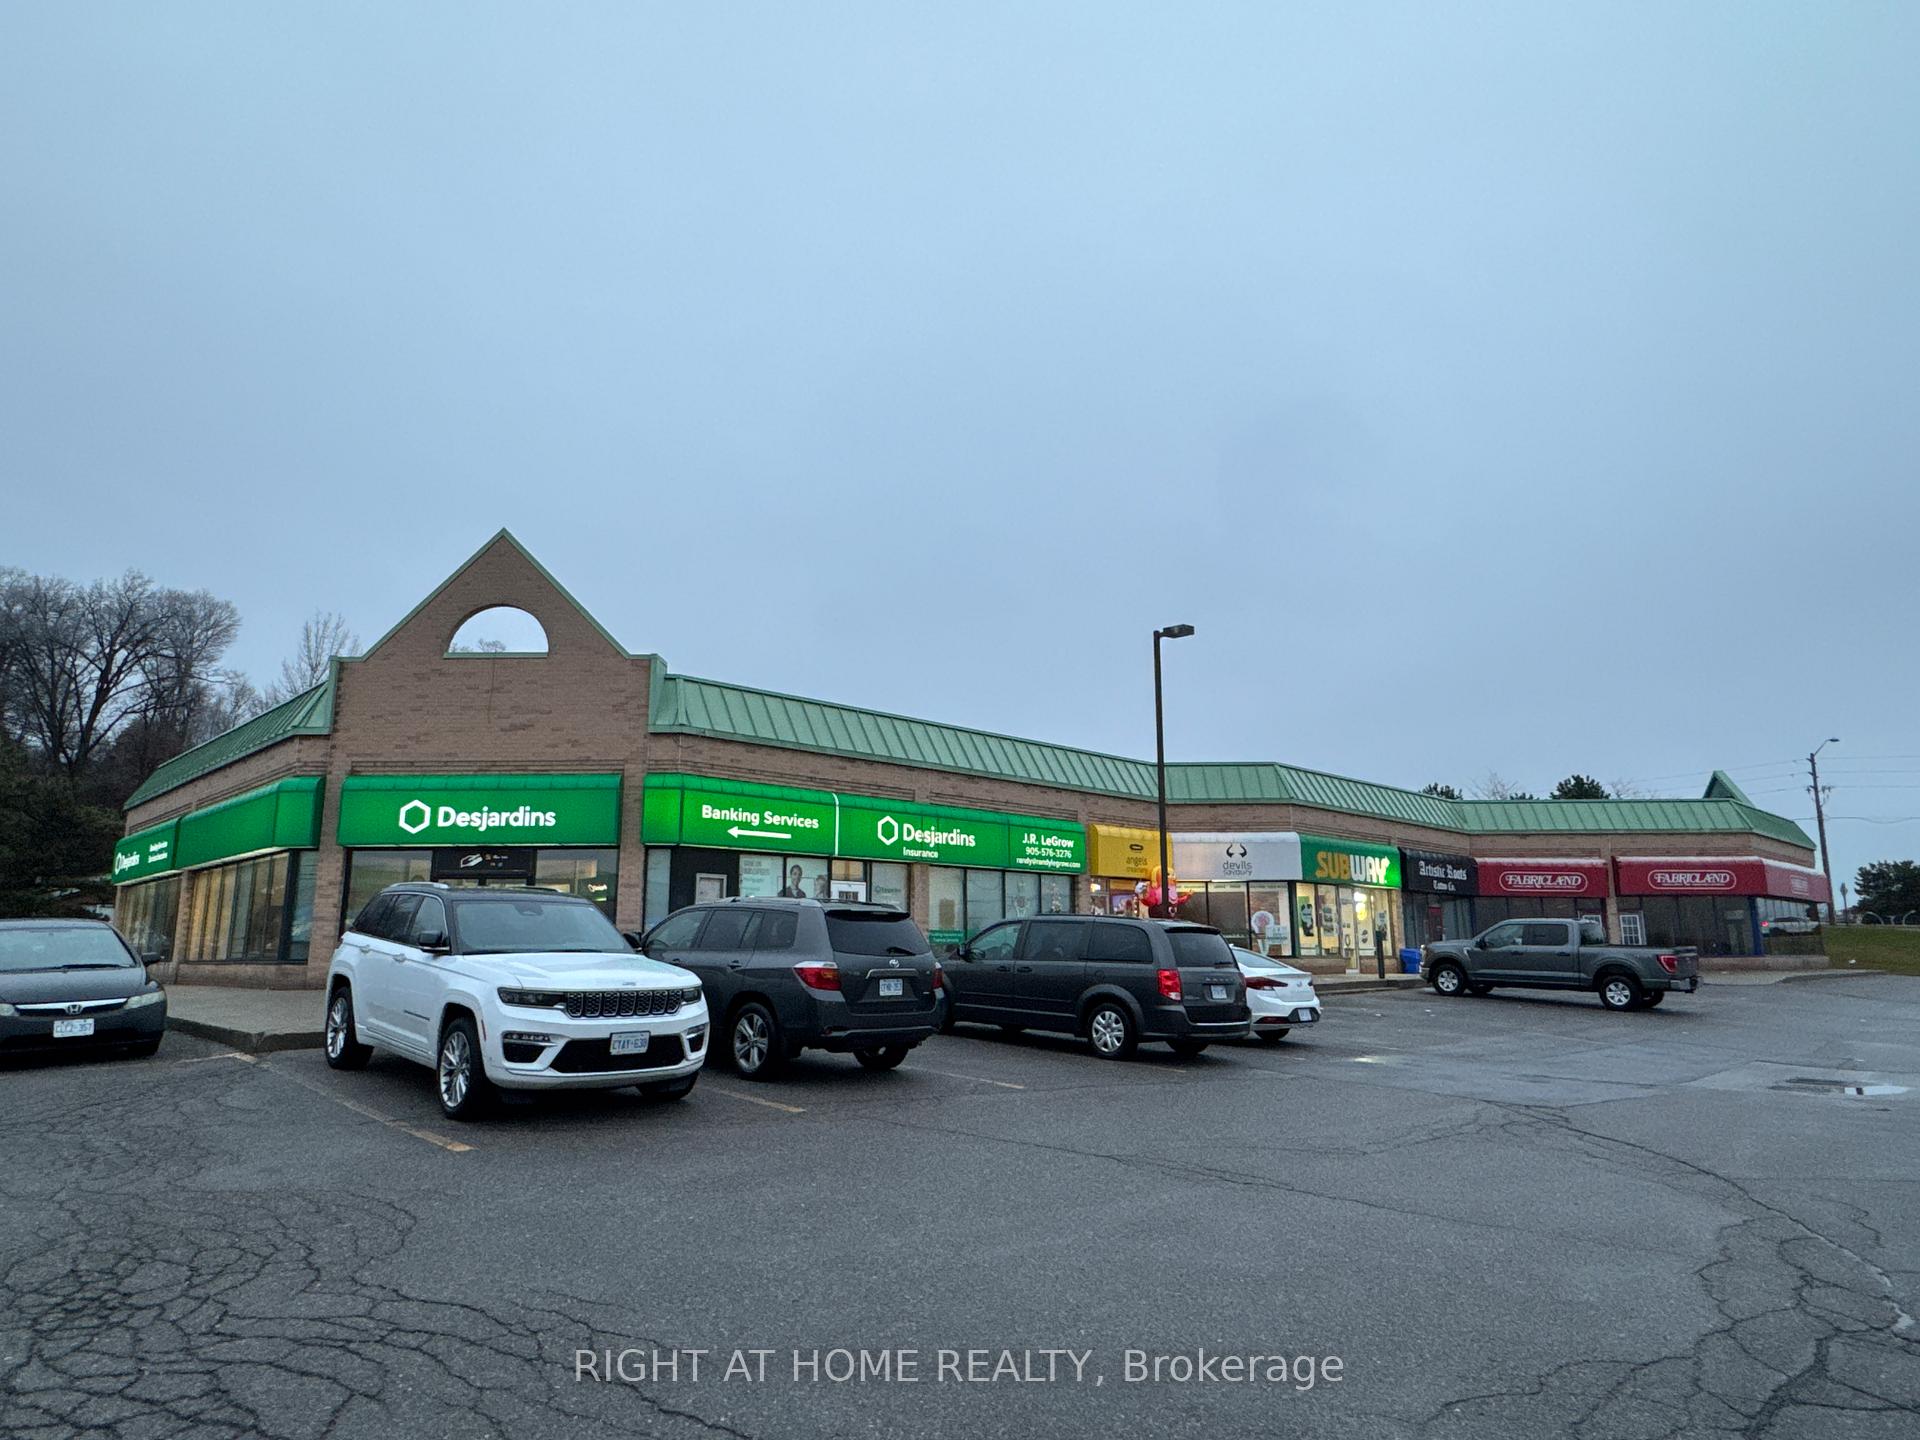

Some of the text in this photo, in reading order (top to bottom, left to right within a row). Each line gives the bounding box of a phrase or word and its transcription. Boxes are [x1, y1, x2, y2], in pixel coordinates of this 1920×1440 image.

[437, 805, 556, 832] Desjardins
[702, 804, 819, 829] Banking Services
[903, 823, 976, 848] Desjardins
[1022, 832, 1075, 848] J.R. LeGrow
[903, 846, 939, 859] Insurance
[1025, 846, 1072, 859] 905-576-3276
[1222, 860, 1253, 870] devils
[1315, 850, 1391, 885] SUBWAY
[1418, 860, 1468, 881] Artistic Roots
[1505, 874, 1581, 889] FABRICLAND
[1654, 873, 1730, 887] FABRICLAND
